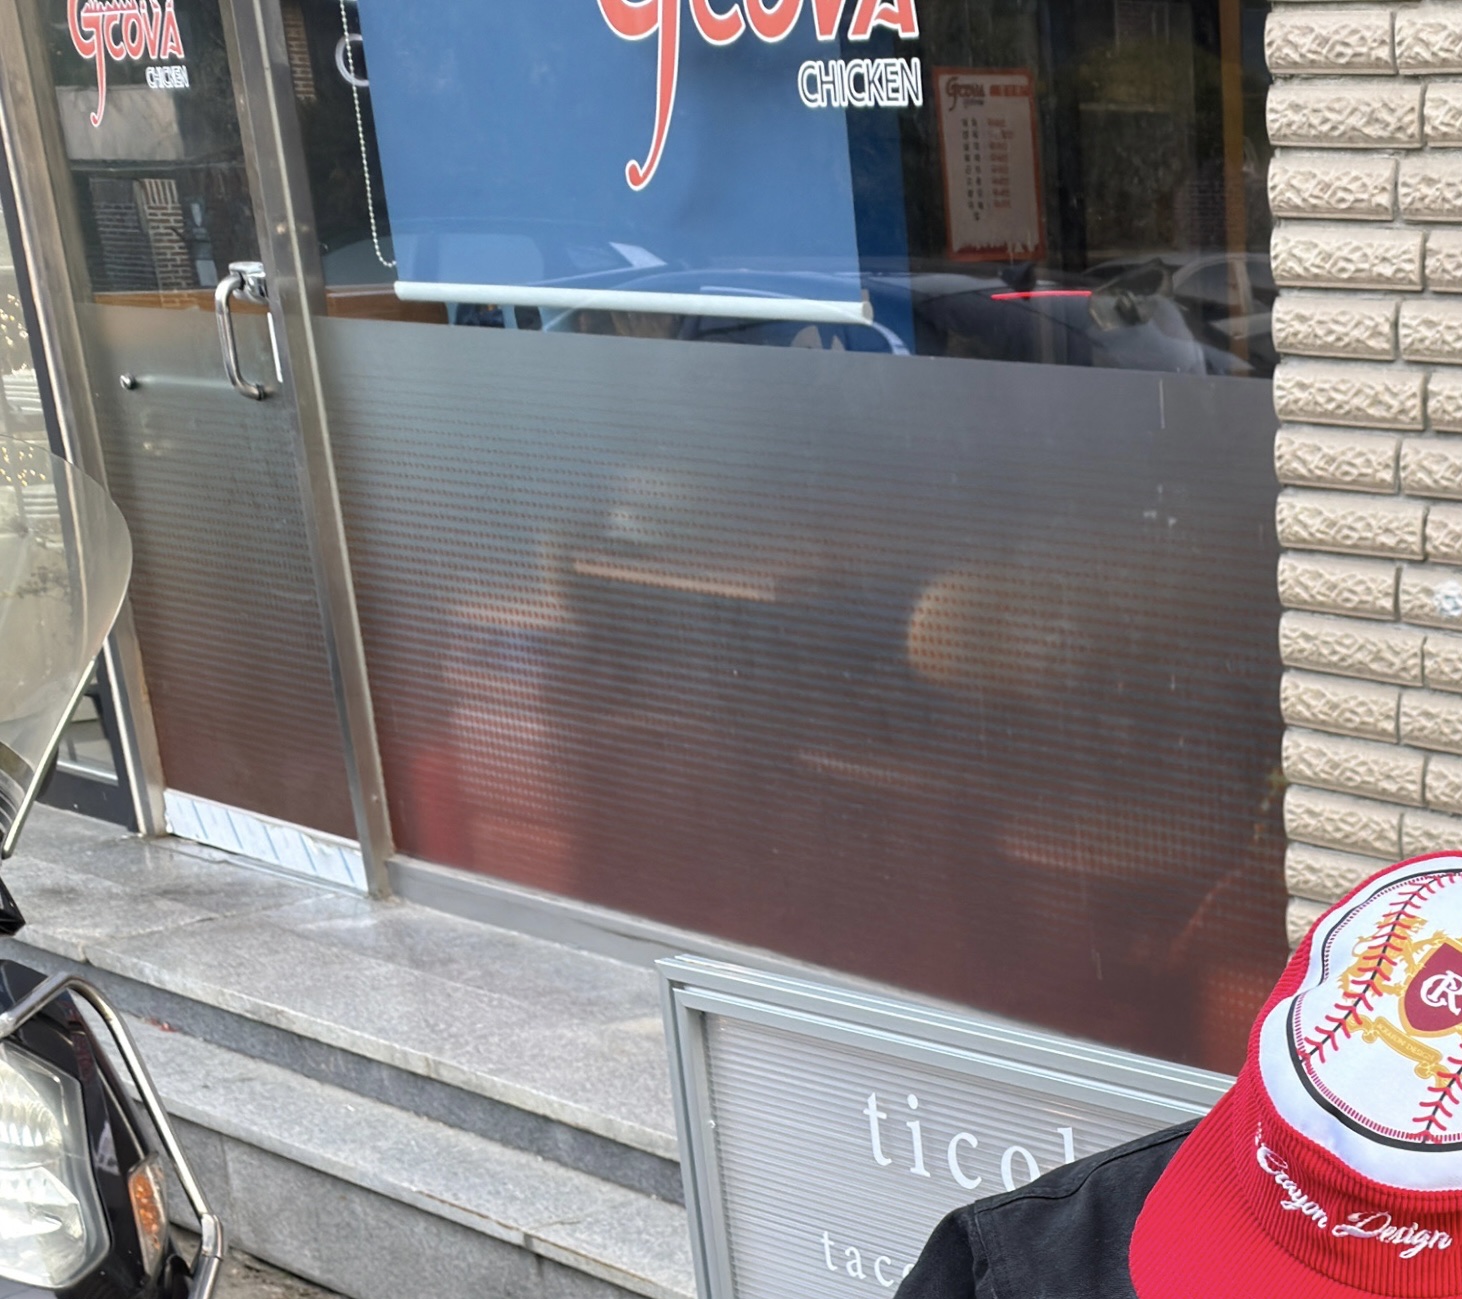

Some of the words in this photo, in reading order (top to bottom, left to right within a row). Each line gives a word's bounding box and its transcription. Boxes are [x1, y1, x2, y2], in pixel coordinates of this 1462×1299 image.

[797, 57, 924, 108] CHICKEN
[1256, 1143, 1329, 1229] Crayon
[1332, 1210, 1454, 1259] Design
[820, 1231, 915, 1287] tac
